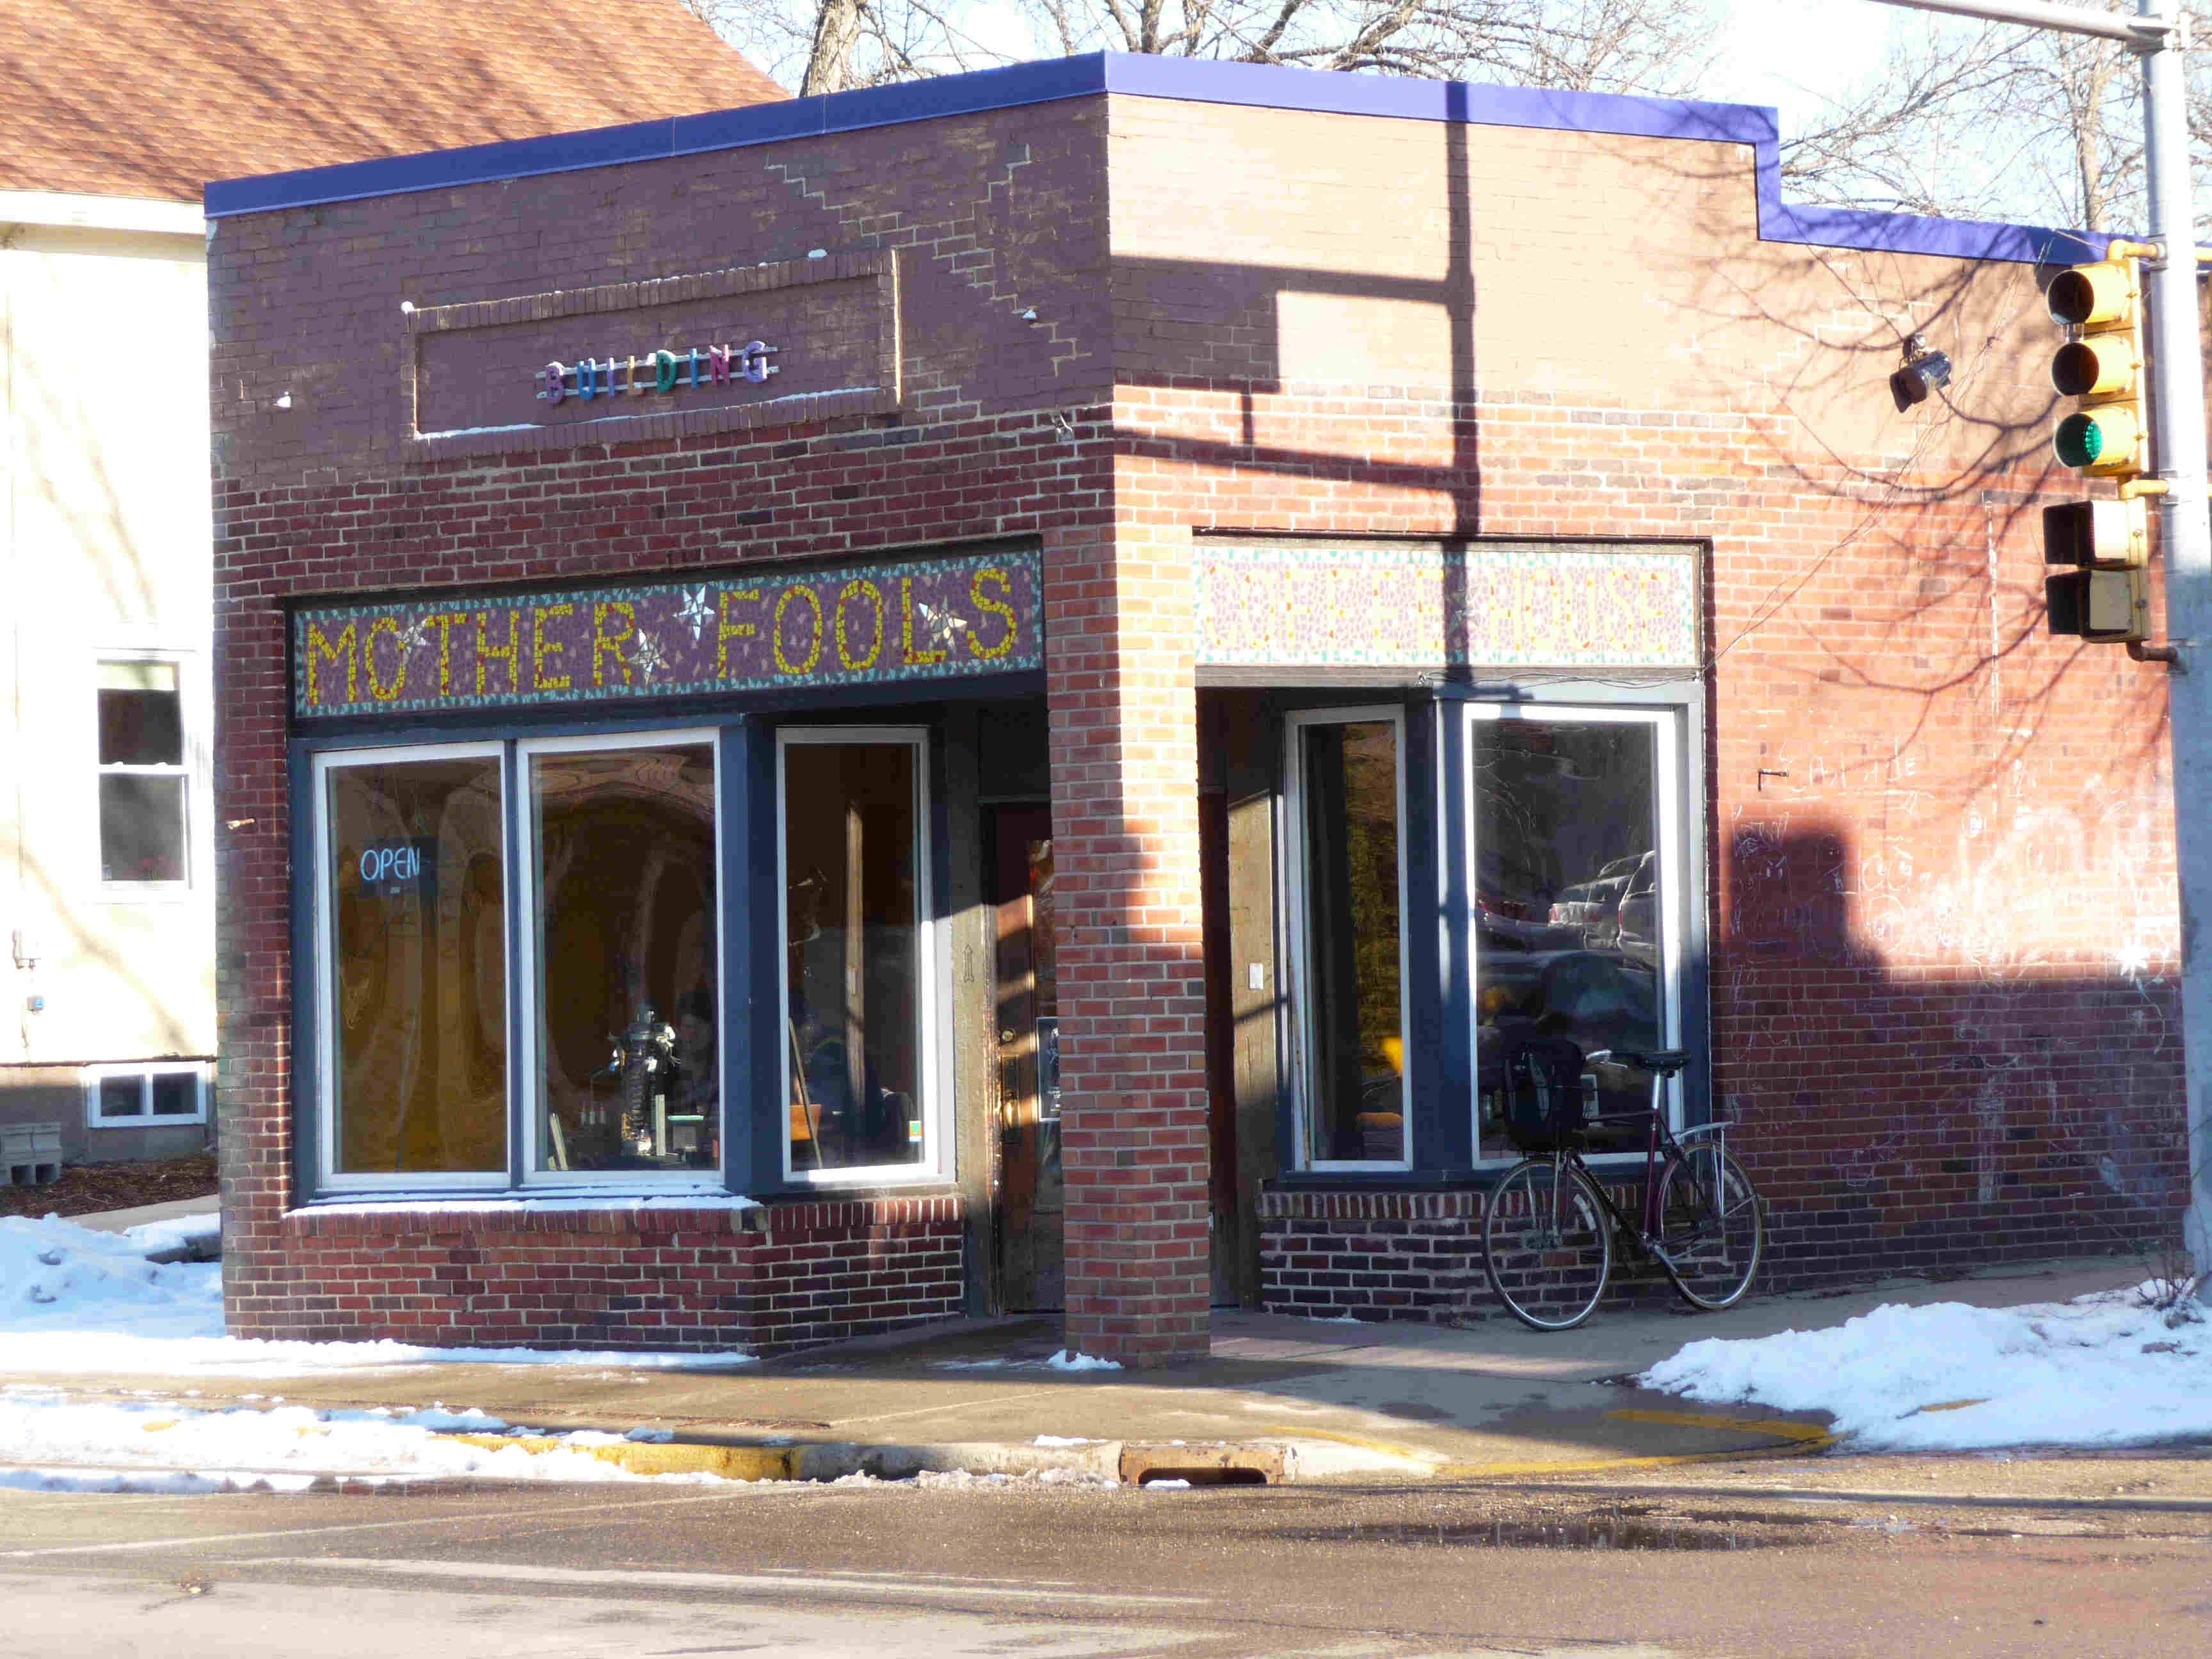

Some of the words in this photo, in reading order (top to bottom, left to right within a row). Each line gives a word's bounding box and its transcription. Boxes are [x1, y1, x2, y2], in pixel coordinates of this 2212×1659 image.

[546, 341, 767, 405] BUILDING
[307, 602, 636, 705] MOTHER
[717, 568, 1018, 678] FOOLS
[1201, 566, 1445, 650] COFFEE
[1489, 566, 1671, 650] HOUSE
[360, 847, 420, 881] OPEN
